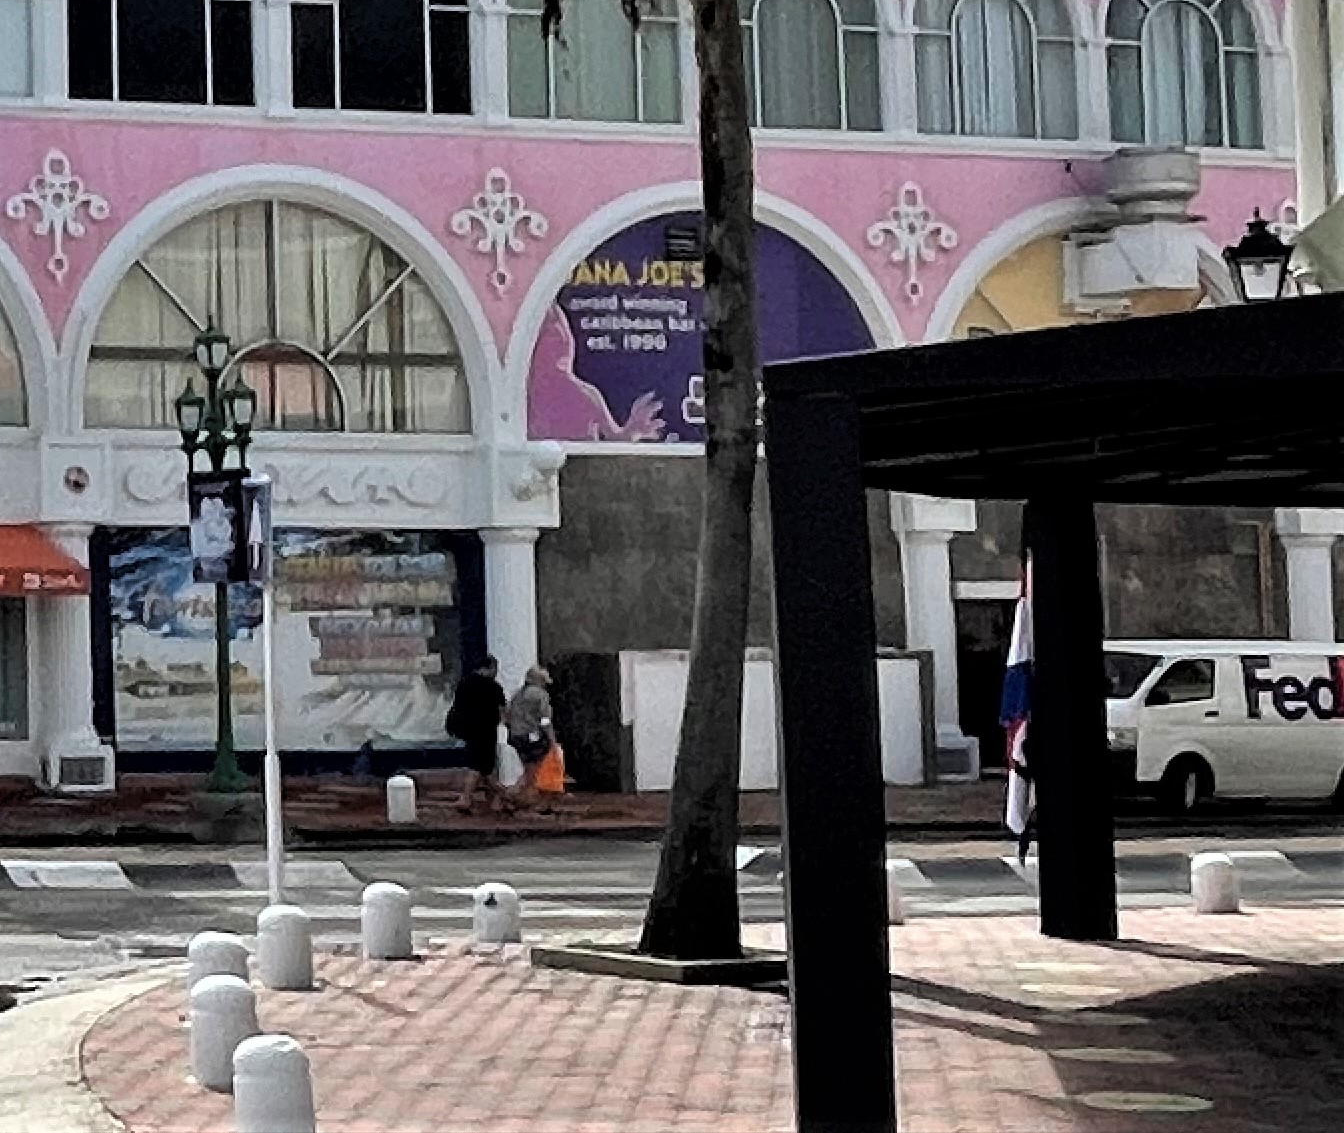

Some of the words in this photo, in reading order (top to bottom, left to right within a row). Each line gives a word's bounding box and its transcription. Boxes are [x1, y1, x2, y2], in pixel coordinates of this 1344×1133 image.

[636, 257, 706, 289] JOE'S
[622, 297, 688, 316] winning
[580, 314, 664, 331] caribbean
